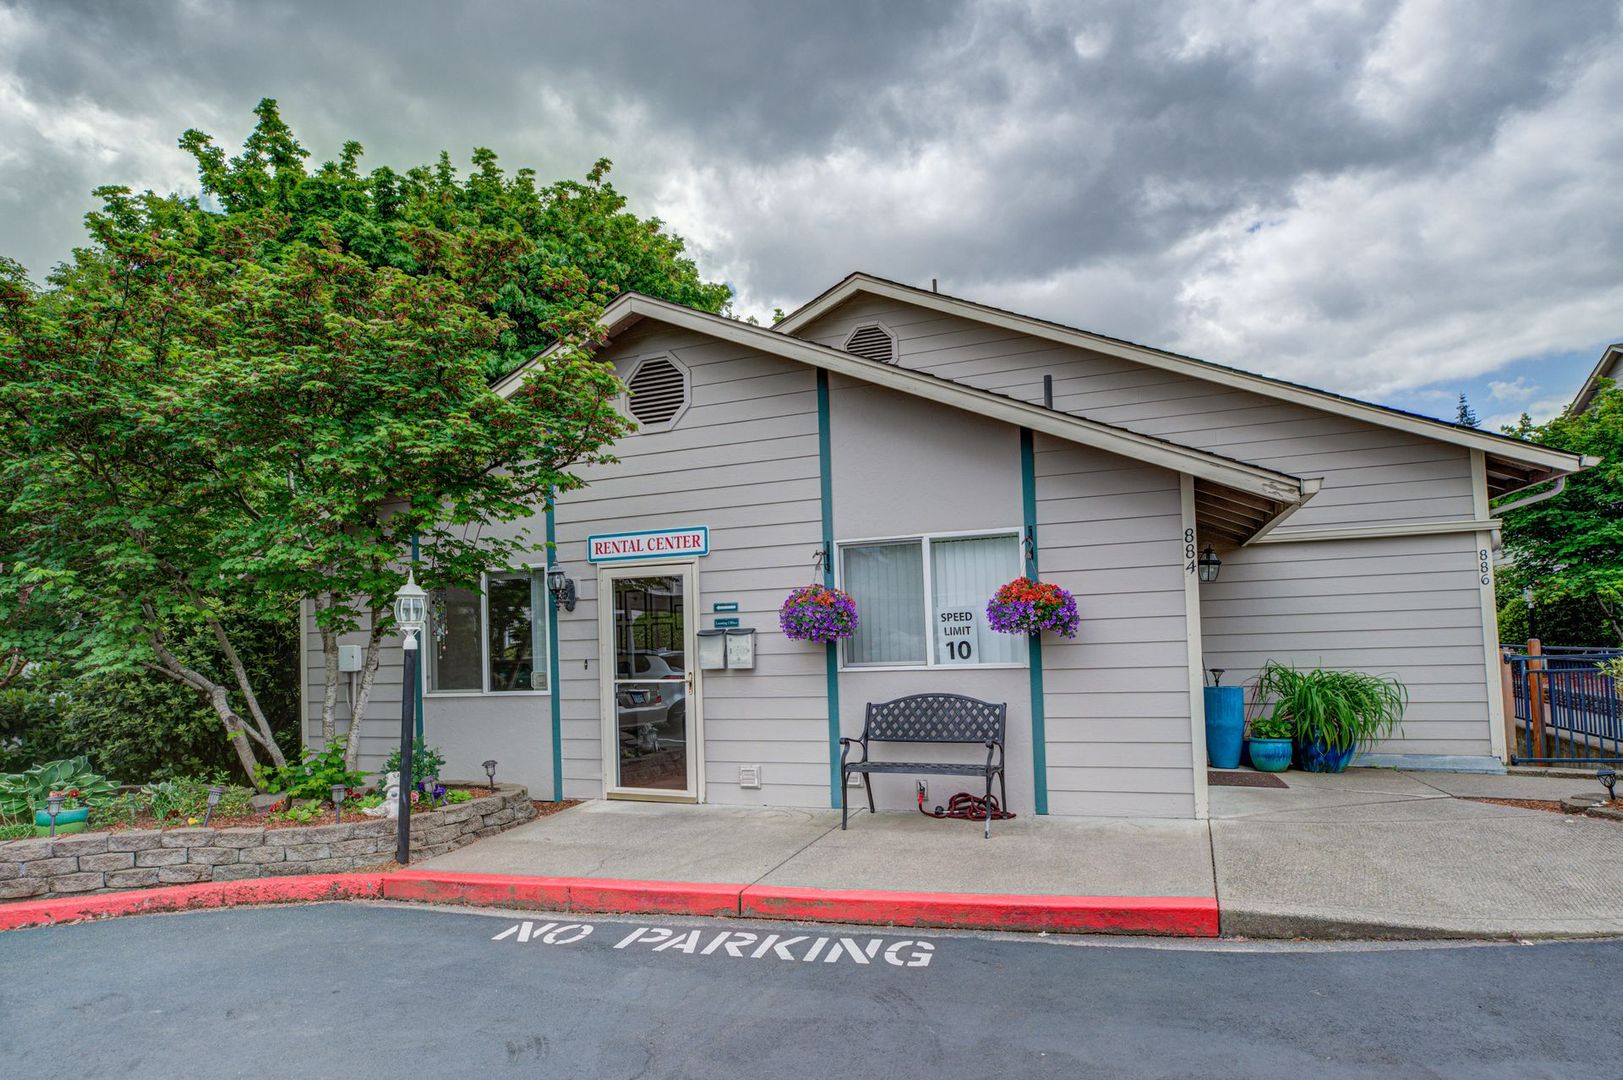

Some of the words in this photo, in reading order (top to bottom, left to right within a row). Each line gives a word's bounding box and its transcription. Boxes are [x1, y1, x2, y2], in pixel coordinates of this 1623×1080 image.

[594, 539, 644, 555] RENTAL
[647, 534, 701, 551] CENTER
[1184, 527, 1197, 575] 884
[1479, 549, 1490, 585] 886
[940, 611, 973, 622] SPEED
[944, 626, 971, 636] LIMIT
[945, 640, 972, 660] 10
[491, 921, 594, 945] NO
[613, 927, 936, 967] PARKING
